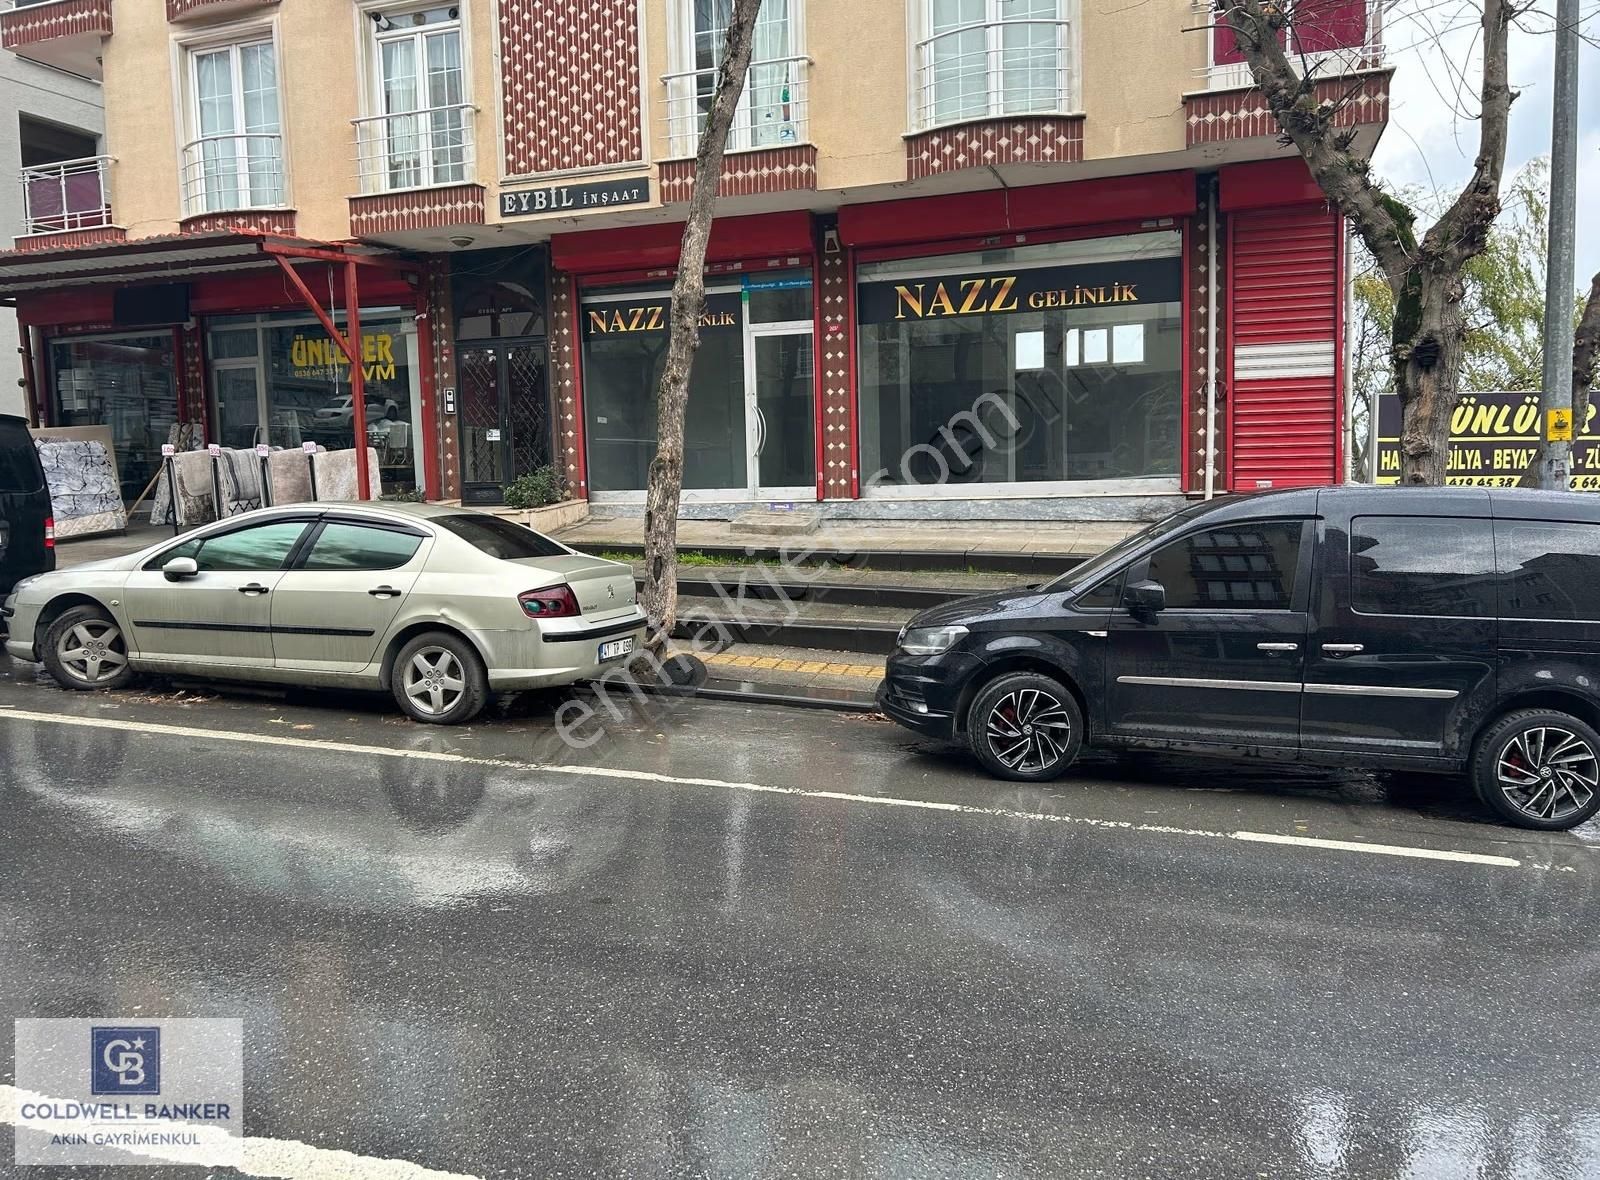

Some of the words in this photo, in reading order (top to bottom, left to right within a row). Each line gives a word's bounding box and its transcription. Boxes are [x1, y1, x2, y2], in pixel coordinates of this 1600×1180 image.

[504, 187, 573, 213] EYBİL
[583, 189, 639, 206] İNŞAAT
[894, 276, 1018, 319] NAZZ
[1028, 281, 1138, 309] GELİNLİK
[588, 306, 665, 334] NAZZ
